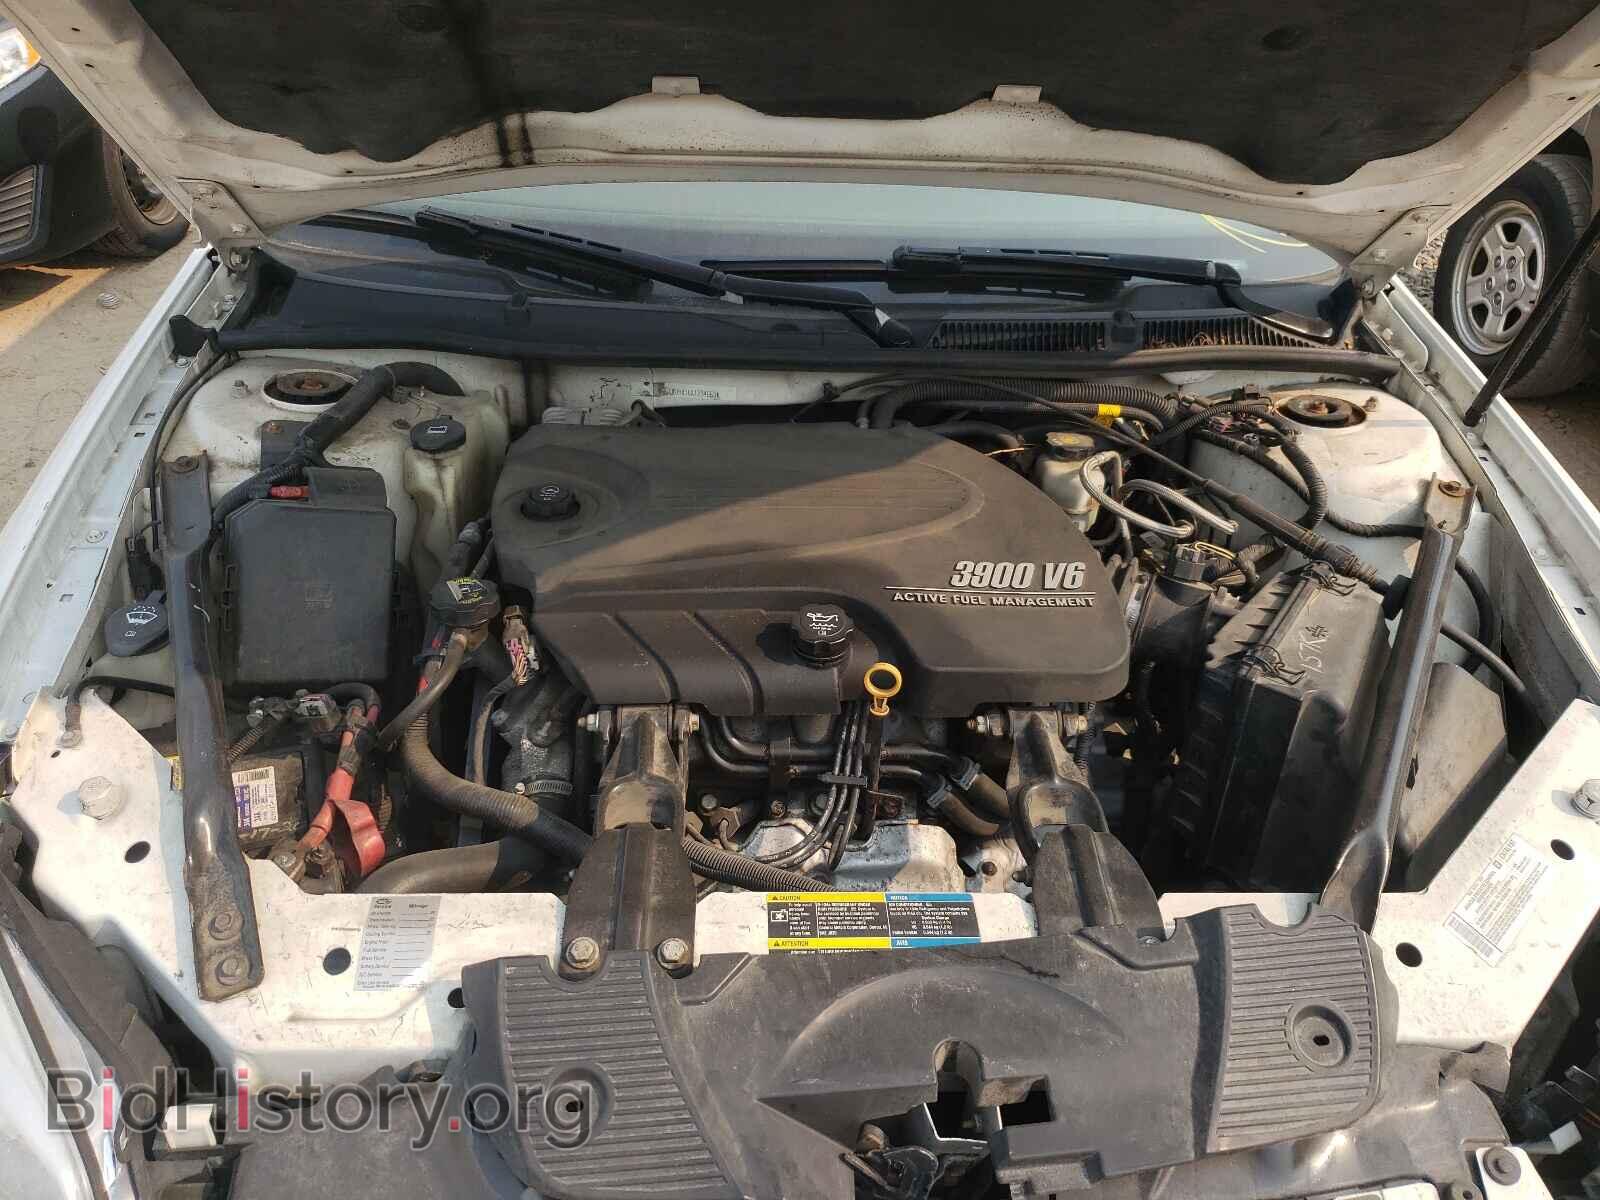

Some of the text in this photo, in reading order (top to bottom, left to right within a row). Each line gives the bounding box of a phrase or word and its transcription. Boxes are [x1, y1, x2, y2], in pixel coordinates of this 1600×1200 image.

[950, 560, 1087, 590] 3900 V6
[893, 592, 1095, 608] ACTIVE FUEL MANAGEMENT
